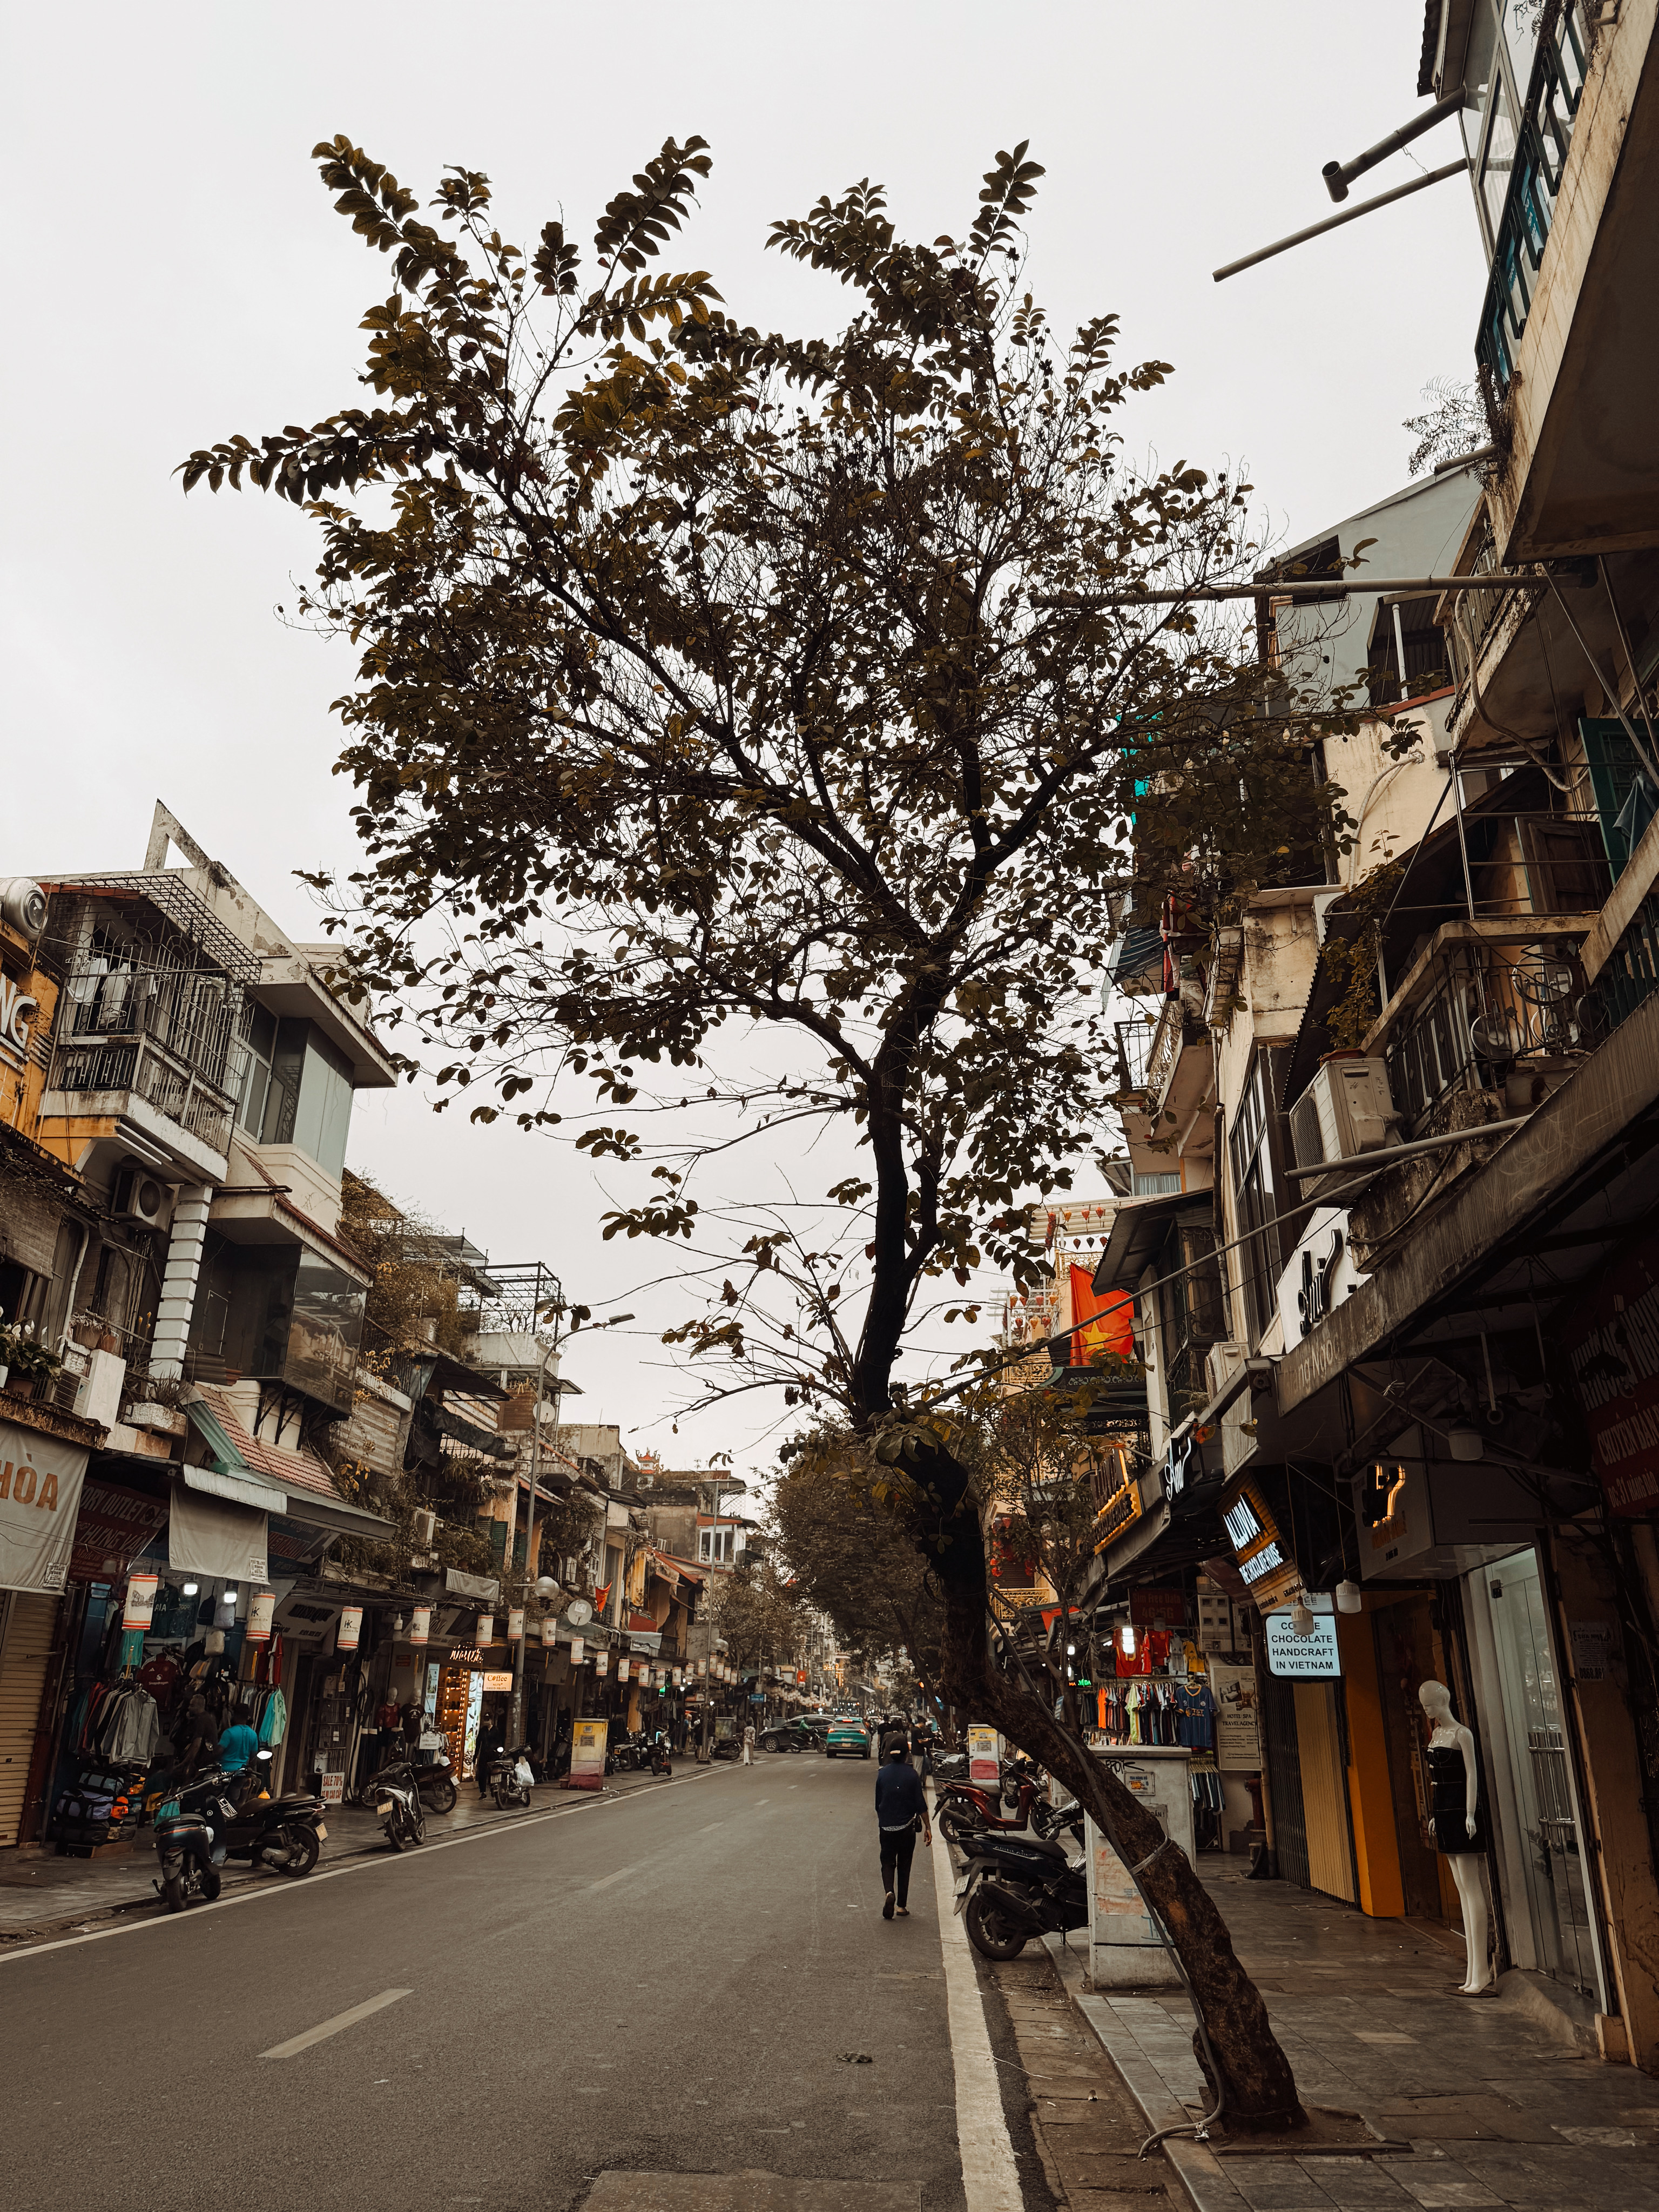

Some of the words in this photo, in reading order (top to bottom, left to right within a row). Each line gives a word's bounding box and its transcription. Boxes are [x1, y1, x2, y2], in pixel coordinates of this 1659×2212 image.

[80, 1485, 108, 1512] ORY
[101, 1493, 147, 1521] OUTLET
[1223, 1494, 1261, 1551] ALLUVIA
[1265, 1542, 1283, 1568] HOUSE
[154, 1603, 166, 1611] AIA
[1288, 1661, 1333, 1669] VIETNAM
[118, 1672, 133, 1681] AA
[323, 1776, 333, 1786] SALE
[334, 1776, 342, 1786] 70%
